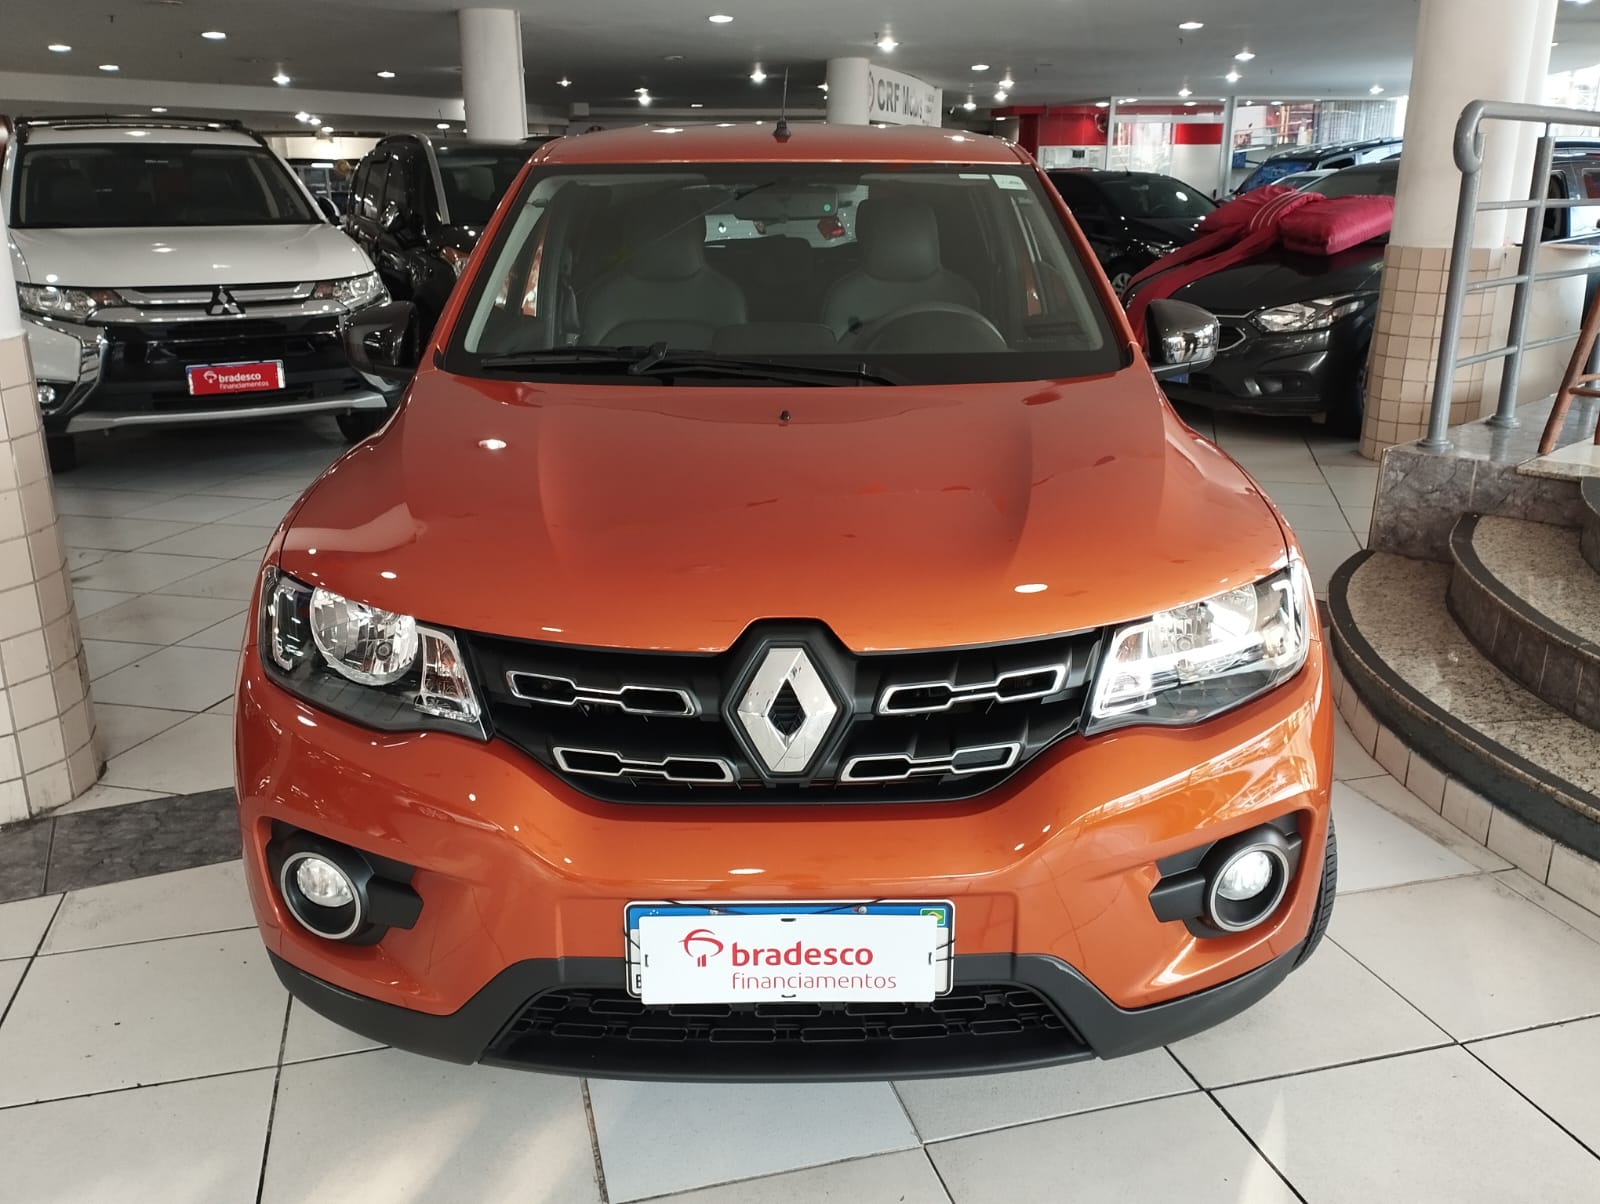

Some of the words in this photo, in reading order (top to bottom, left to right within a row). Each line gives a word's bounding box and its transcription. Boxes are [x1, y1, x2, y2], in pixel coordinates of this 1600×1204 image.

[877, 79, 900, 113] CRF
[218, 372, 262, 384] bradesco
[219, 380, 270, 390] financiamentos
[731, 940, 874, 967] bradesco
[732, 971, 897, 990] financiamentos
